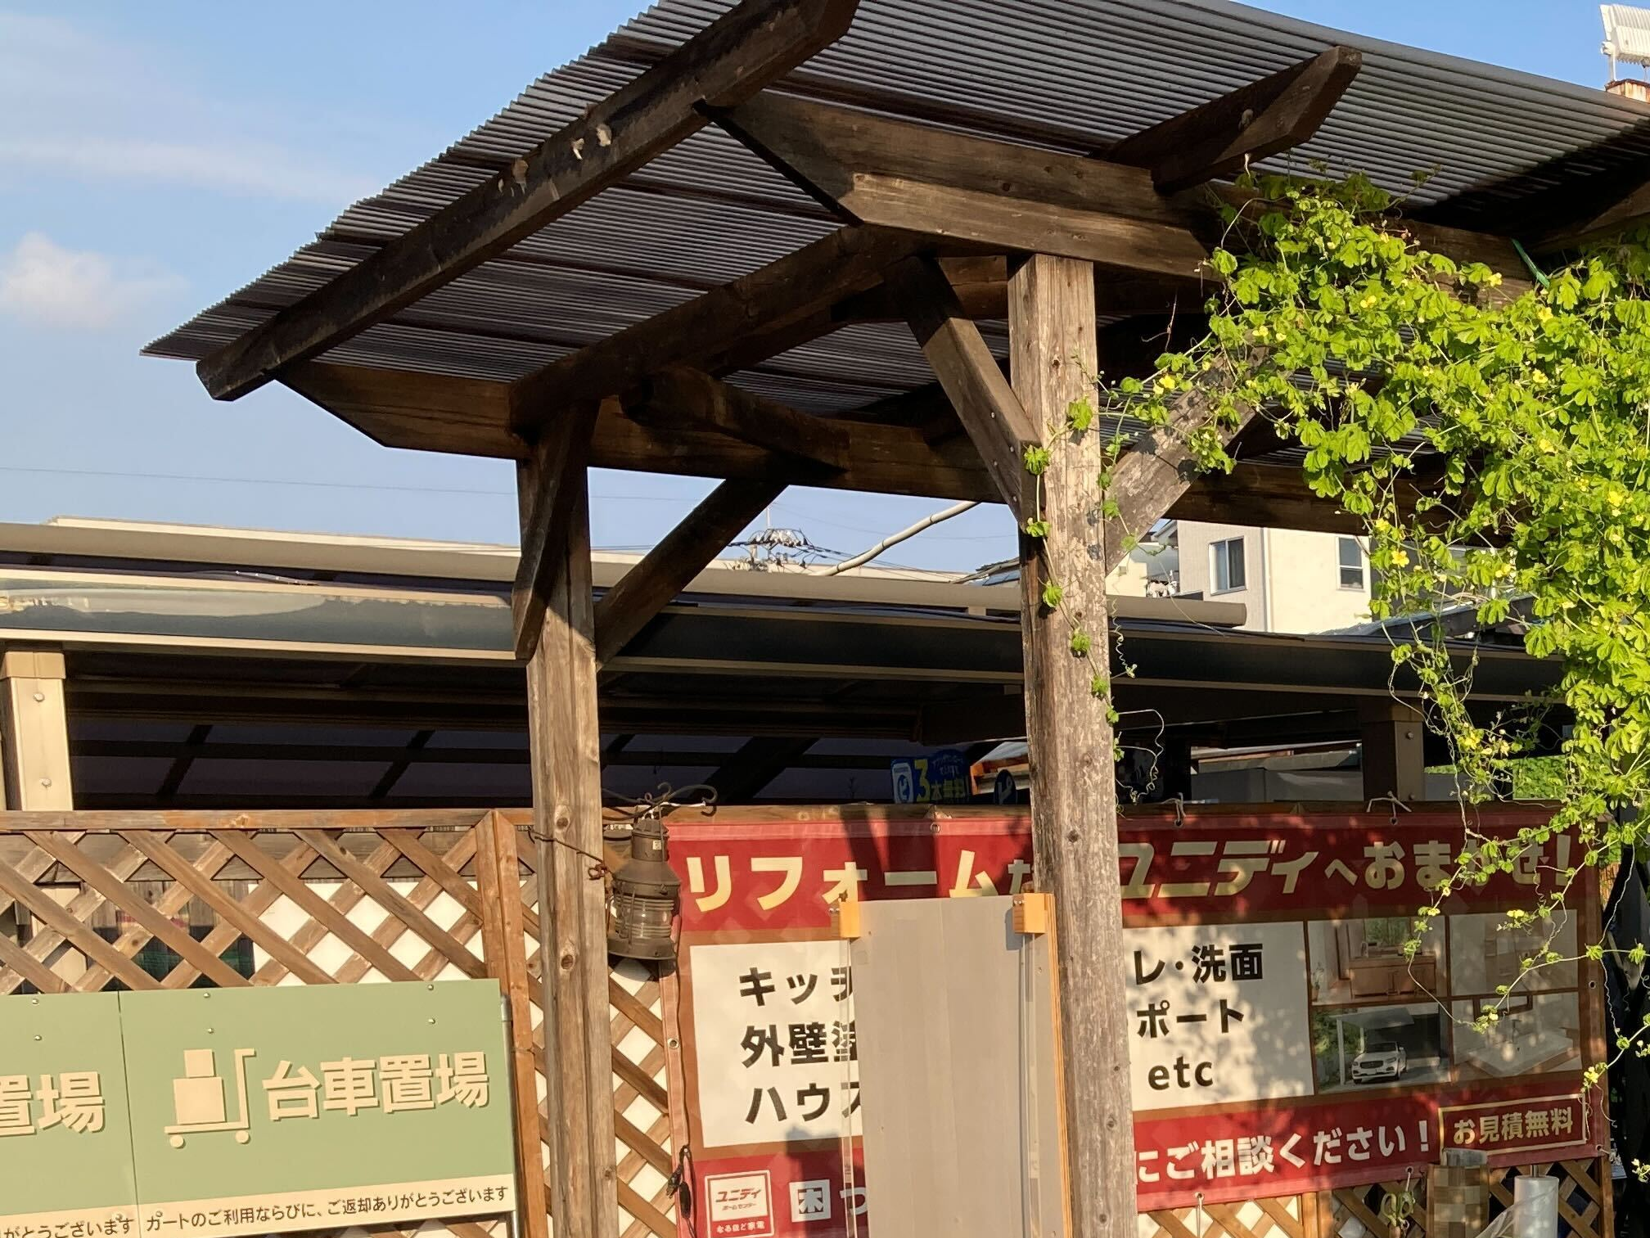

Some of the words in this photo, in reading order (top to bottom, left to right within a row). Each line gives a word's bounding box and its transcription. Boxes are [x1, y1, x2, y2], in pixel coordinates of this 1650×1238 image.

[1136, 999, 1245, 1039] ポート
[262, 1051, 490, 1121] 台車置場
[1147, 1055, 1214, 1091] etc
[1453, 1107, 1573, 1145] お見積無料
